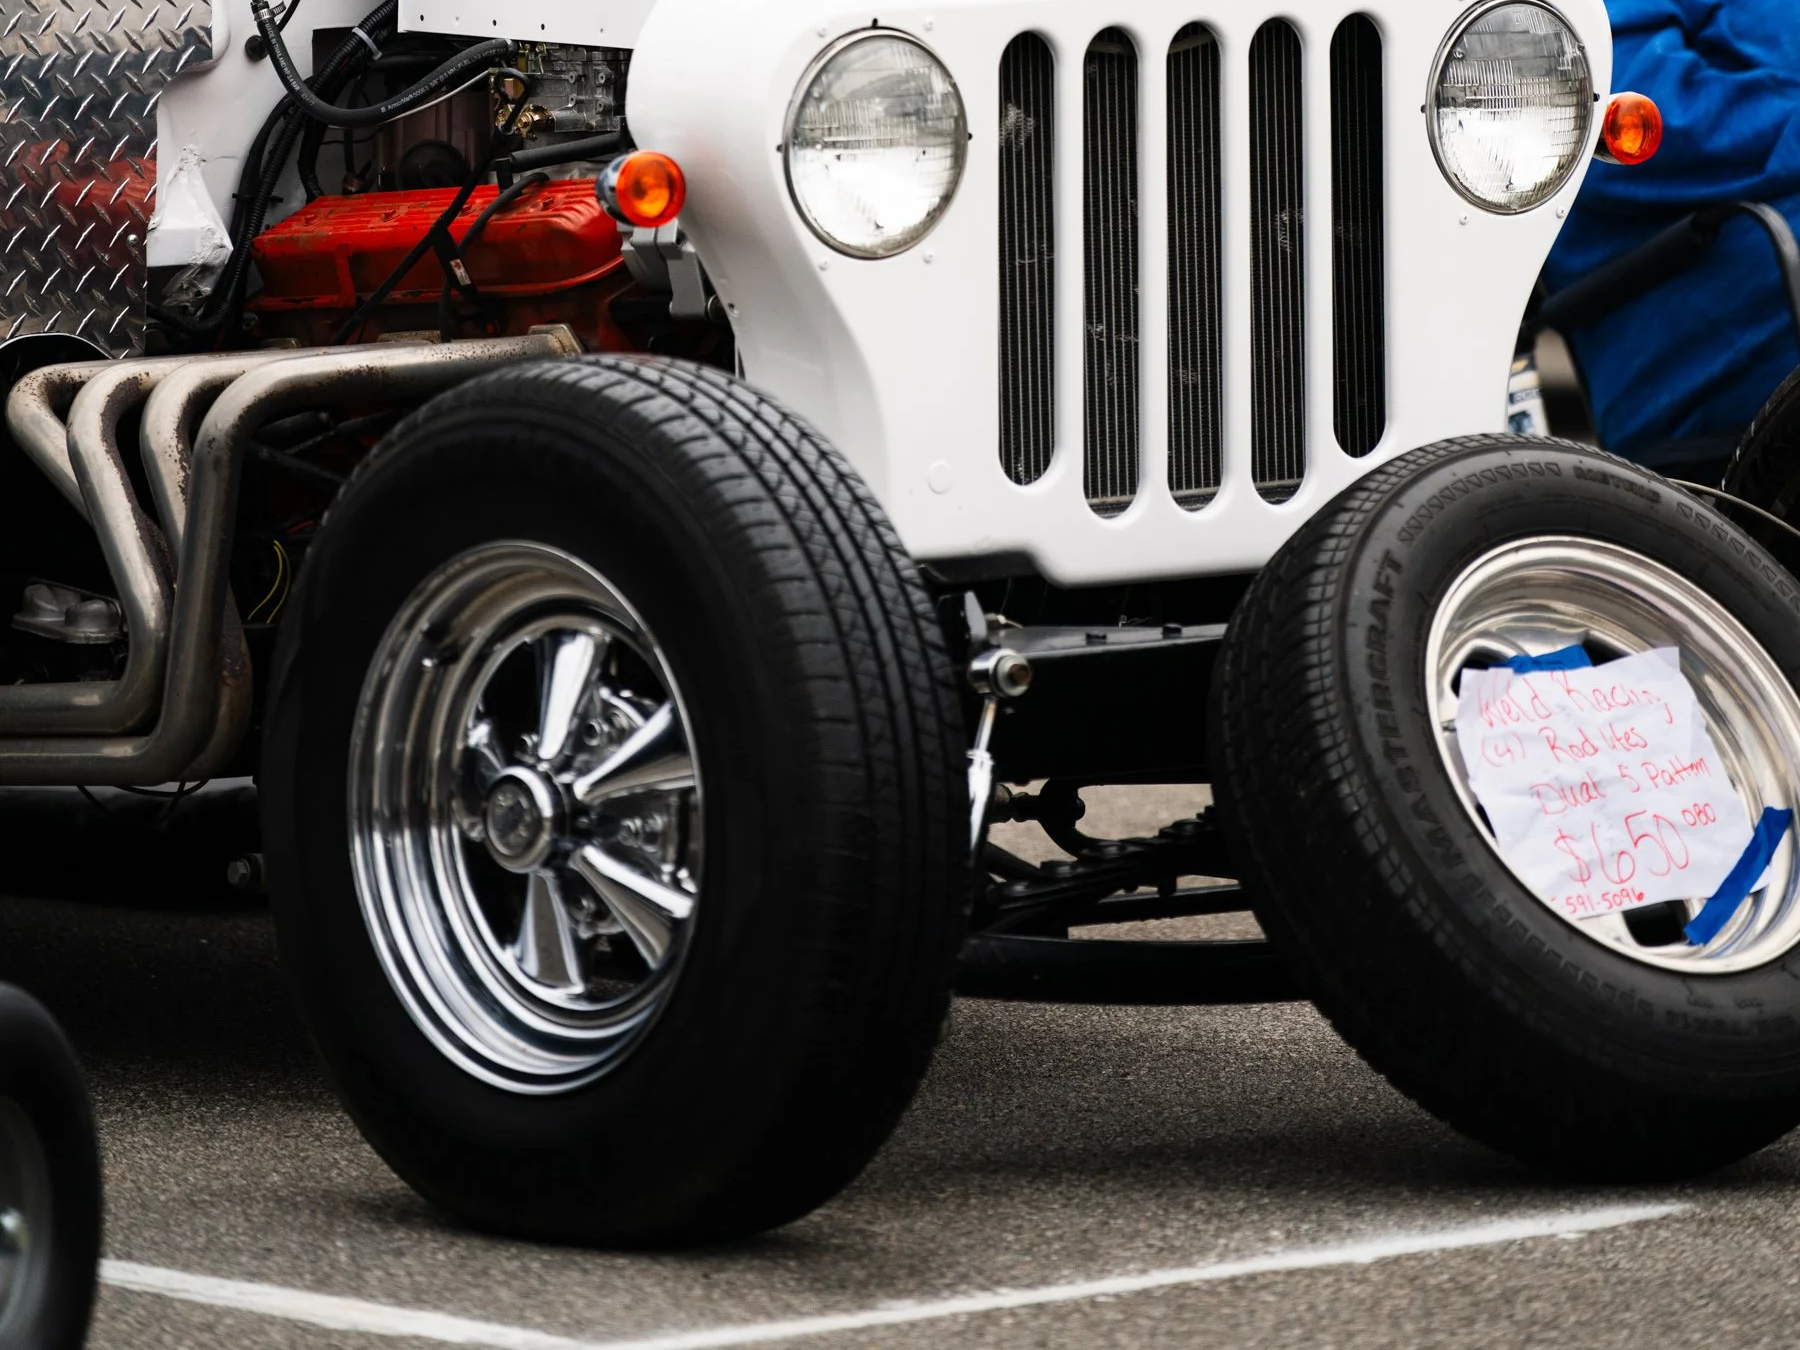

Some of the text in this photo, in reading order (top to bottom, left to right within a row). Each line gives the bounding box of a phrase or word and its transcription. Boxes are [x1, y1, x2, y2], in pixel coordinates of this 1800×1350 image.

[1477, 675, 1554, 729] Weld
[1480, 730, 1527, 768] (4)
[1537, 725, 1600, 764] Rod
[1529, 770, 1607, 816] Dual
[1617, 764, 1641, 794] 5
[1553, 802, 1717, 888] $650 OBO
